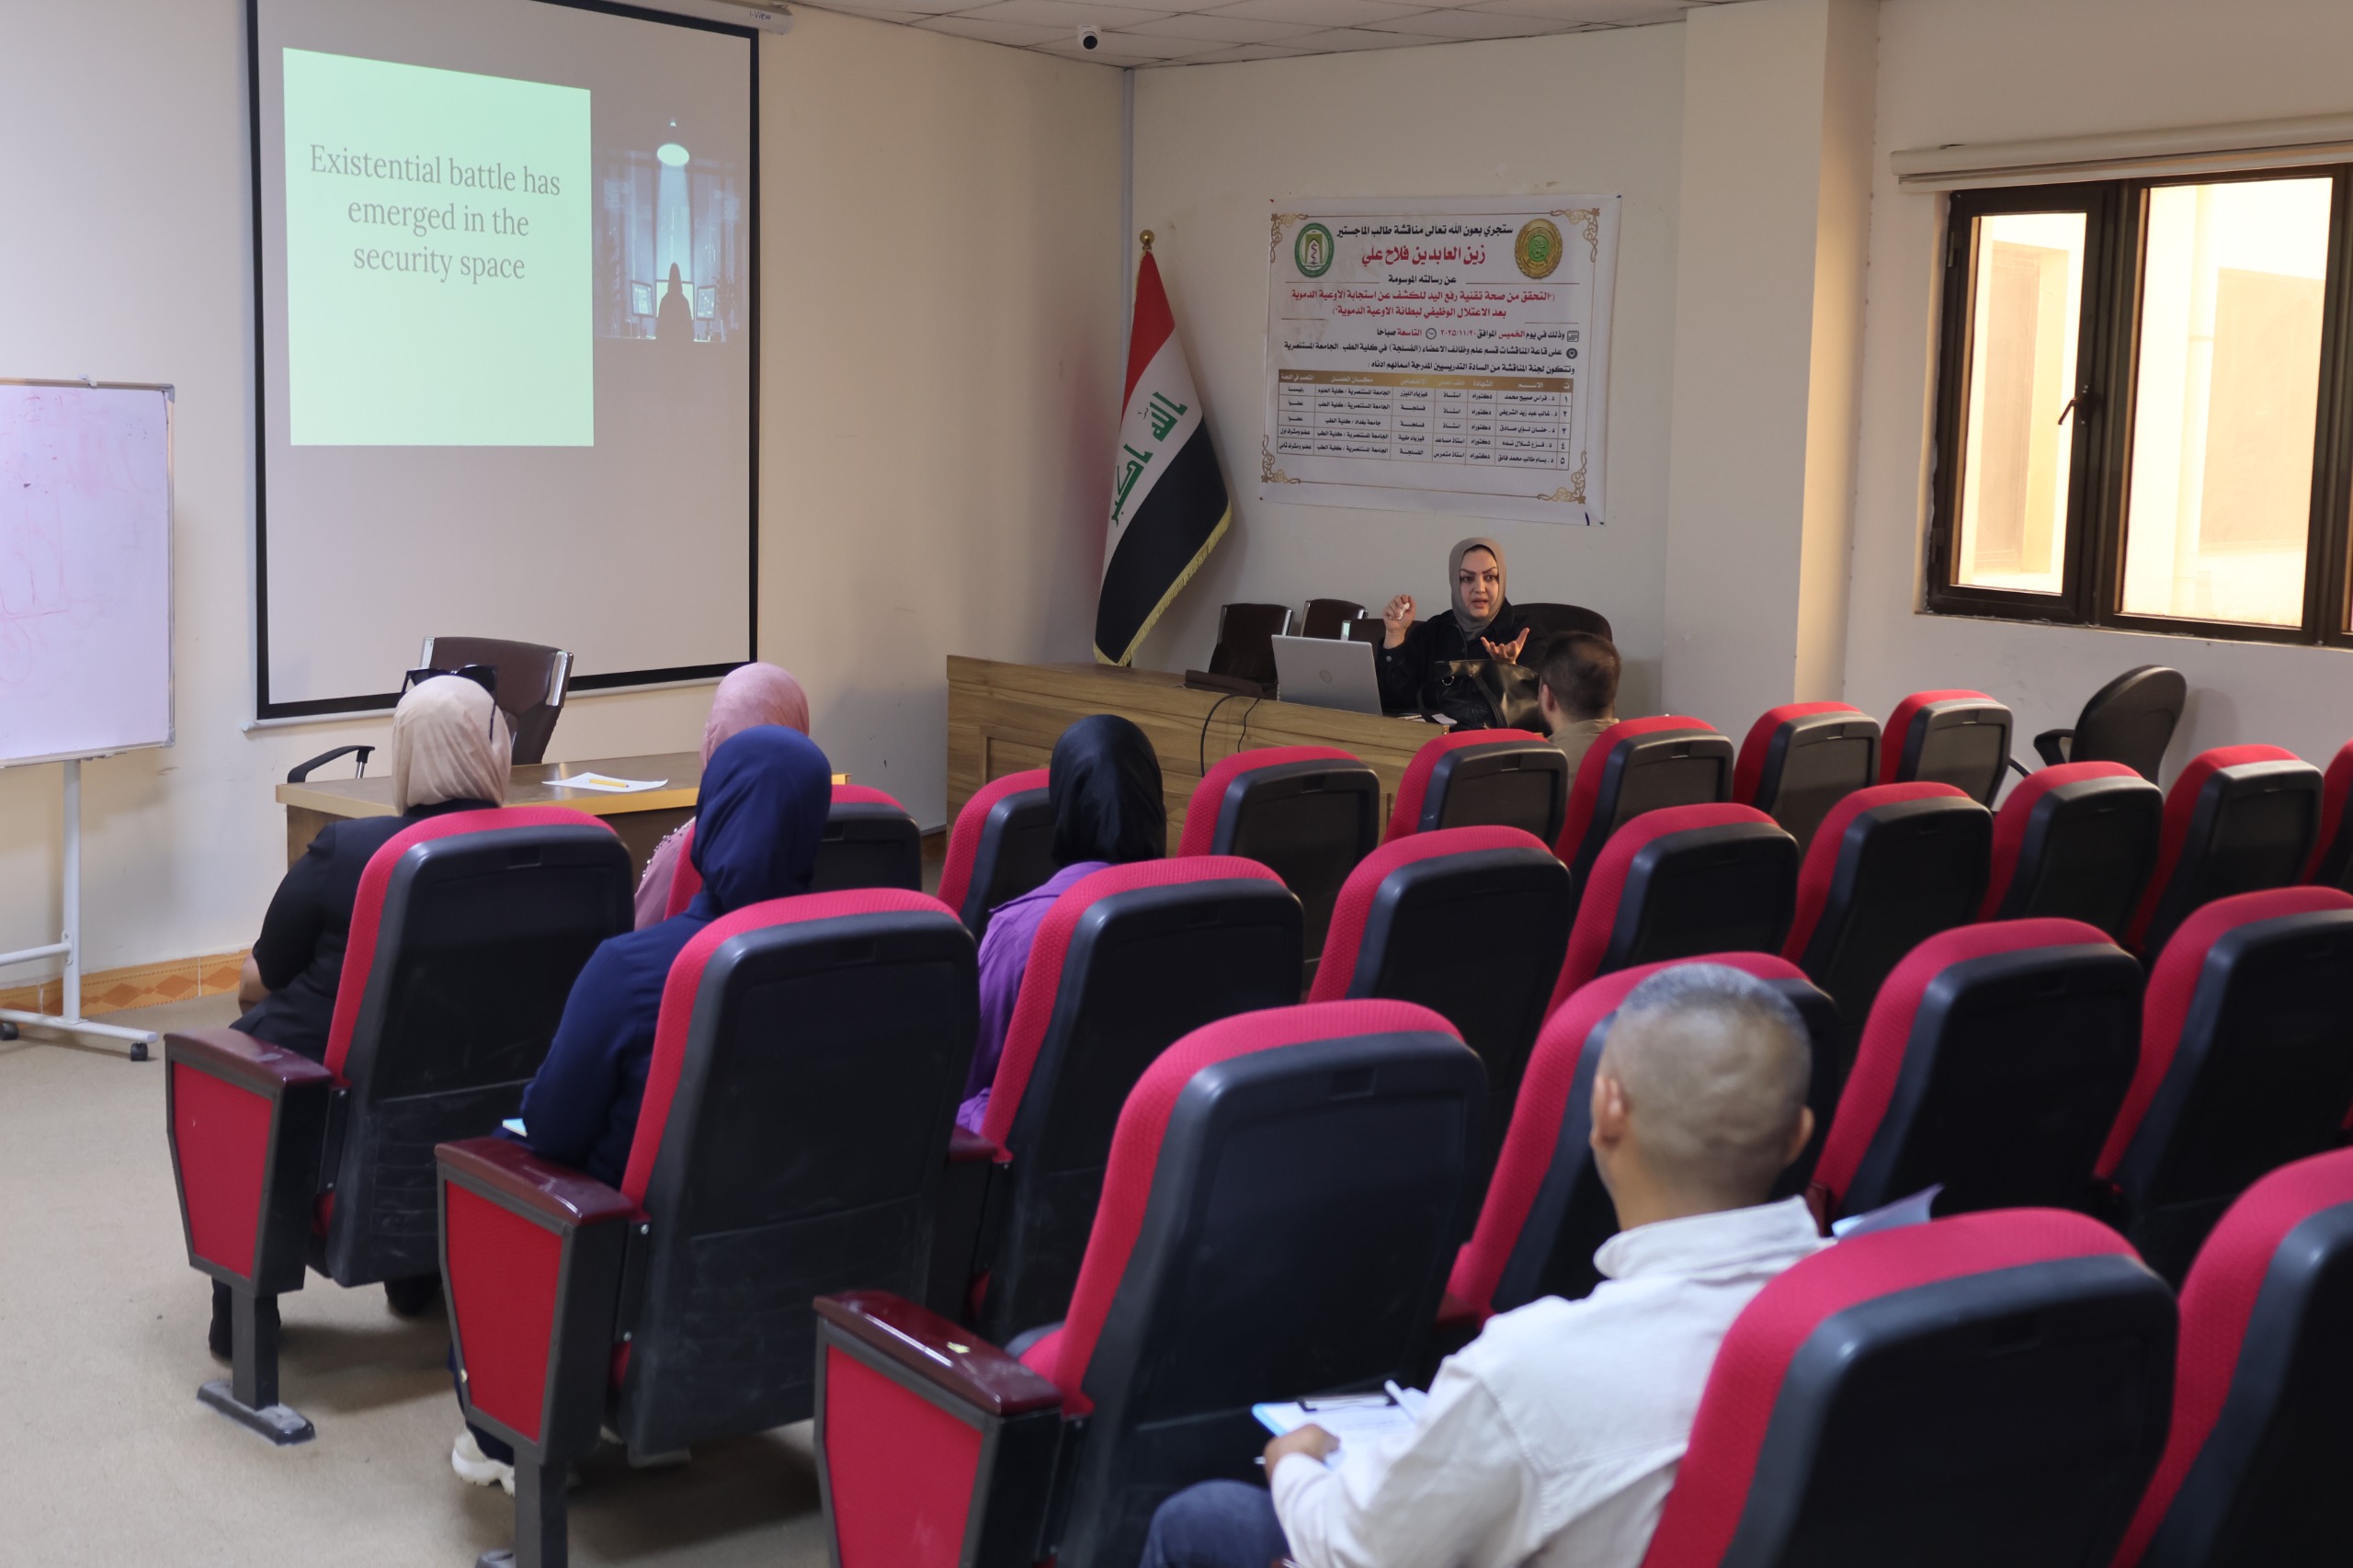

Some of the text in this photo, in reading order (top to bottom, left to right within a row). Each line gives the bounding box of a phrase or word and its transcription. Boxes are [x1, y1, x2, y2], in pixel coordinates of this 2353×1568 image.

[311, 144, 560, 196] Existential battle has
[348, 201, 529, 237] emerged in the
[1336, 223, 1513, 237] ستجري بعون الله تعالى مناقشة طالب الماجستير
[1361, 244, 1485, 267] زين العابدين فلاح علي
[354, 246, 525, 285] security space
[1389, 275, 1456, 285] عن رسالته الموسومة
[1291, 290, 1317, 301] الدموية
[1319, 290, 1345, 301] الاوعية
[1347, 290, 1376, 301] استجابة
[1378, 291, 1390, 301] عن
[1392, 290, 1426, 300] للكشف
[1428, 291, 1443, 301] اليد
[1444, 291, 1458, 303] رفع
[1460, 291, 1482, 302] تقنية
[1484, 291, 1505, 301] صحة
[1507, 292, 1519, 302] من
[1367, 306, 1393, 317] الاوعية
[1395, 306, 1422, 317] لبطانة
[1424, 306, 1455, 319] الوظيفي
[1457, 308, 1490, 318] الاعتلال
[1492, 310, 1506, 319] بعد
[1397, 328, 1422, 336] التاسعة
[1477, 330, 1496, 339] الموافق
[1498, 330, 1525, 340] الخميس
[1526, 332, 1537, 340] يوم
[1537, 331, 1547, 340] في
[1548, 330, 1564, 340] وذلك
[1284, 341, 1314, 350] المستنصرية
[1315, 343, 1338, 352] الجامعة
[1343, 343, 1358, 352] الطب
[1359, 344, 1378, 352] كلية
[1379, 345, 1387, 354] في
[1422, 345, 1448, 353] الاعضاء
[1448, 346, 1469, 355] وظائف
[1471, 346, 1483, 355] علم
[1499, 346, 1529, 355] المناقشات
[1483, 347, 1498, 356] قسم
[1549, 348, 1562, 357] على
[1411, 361, 1433, 370] المدرجة
[1434, 362, 1467, 371] التدريسيين
[1490, 364, 1500, 373] من
[1502, 362, 1527, 372] المناقشة
[1529, 365, 1544, 374] لجنة
